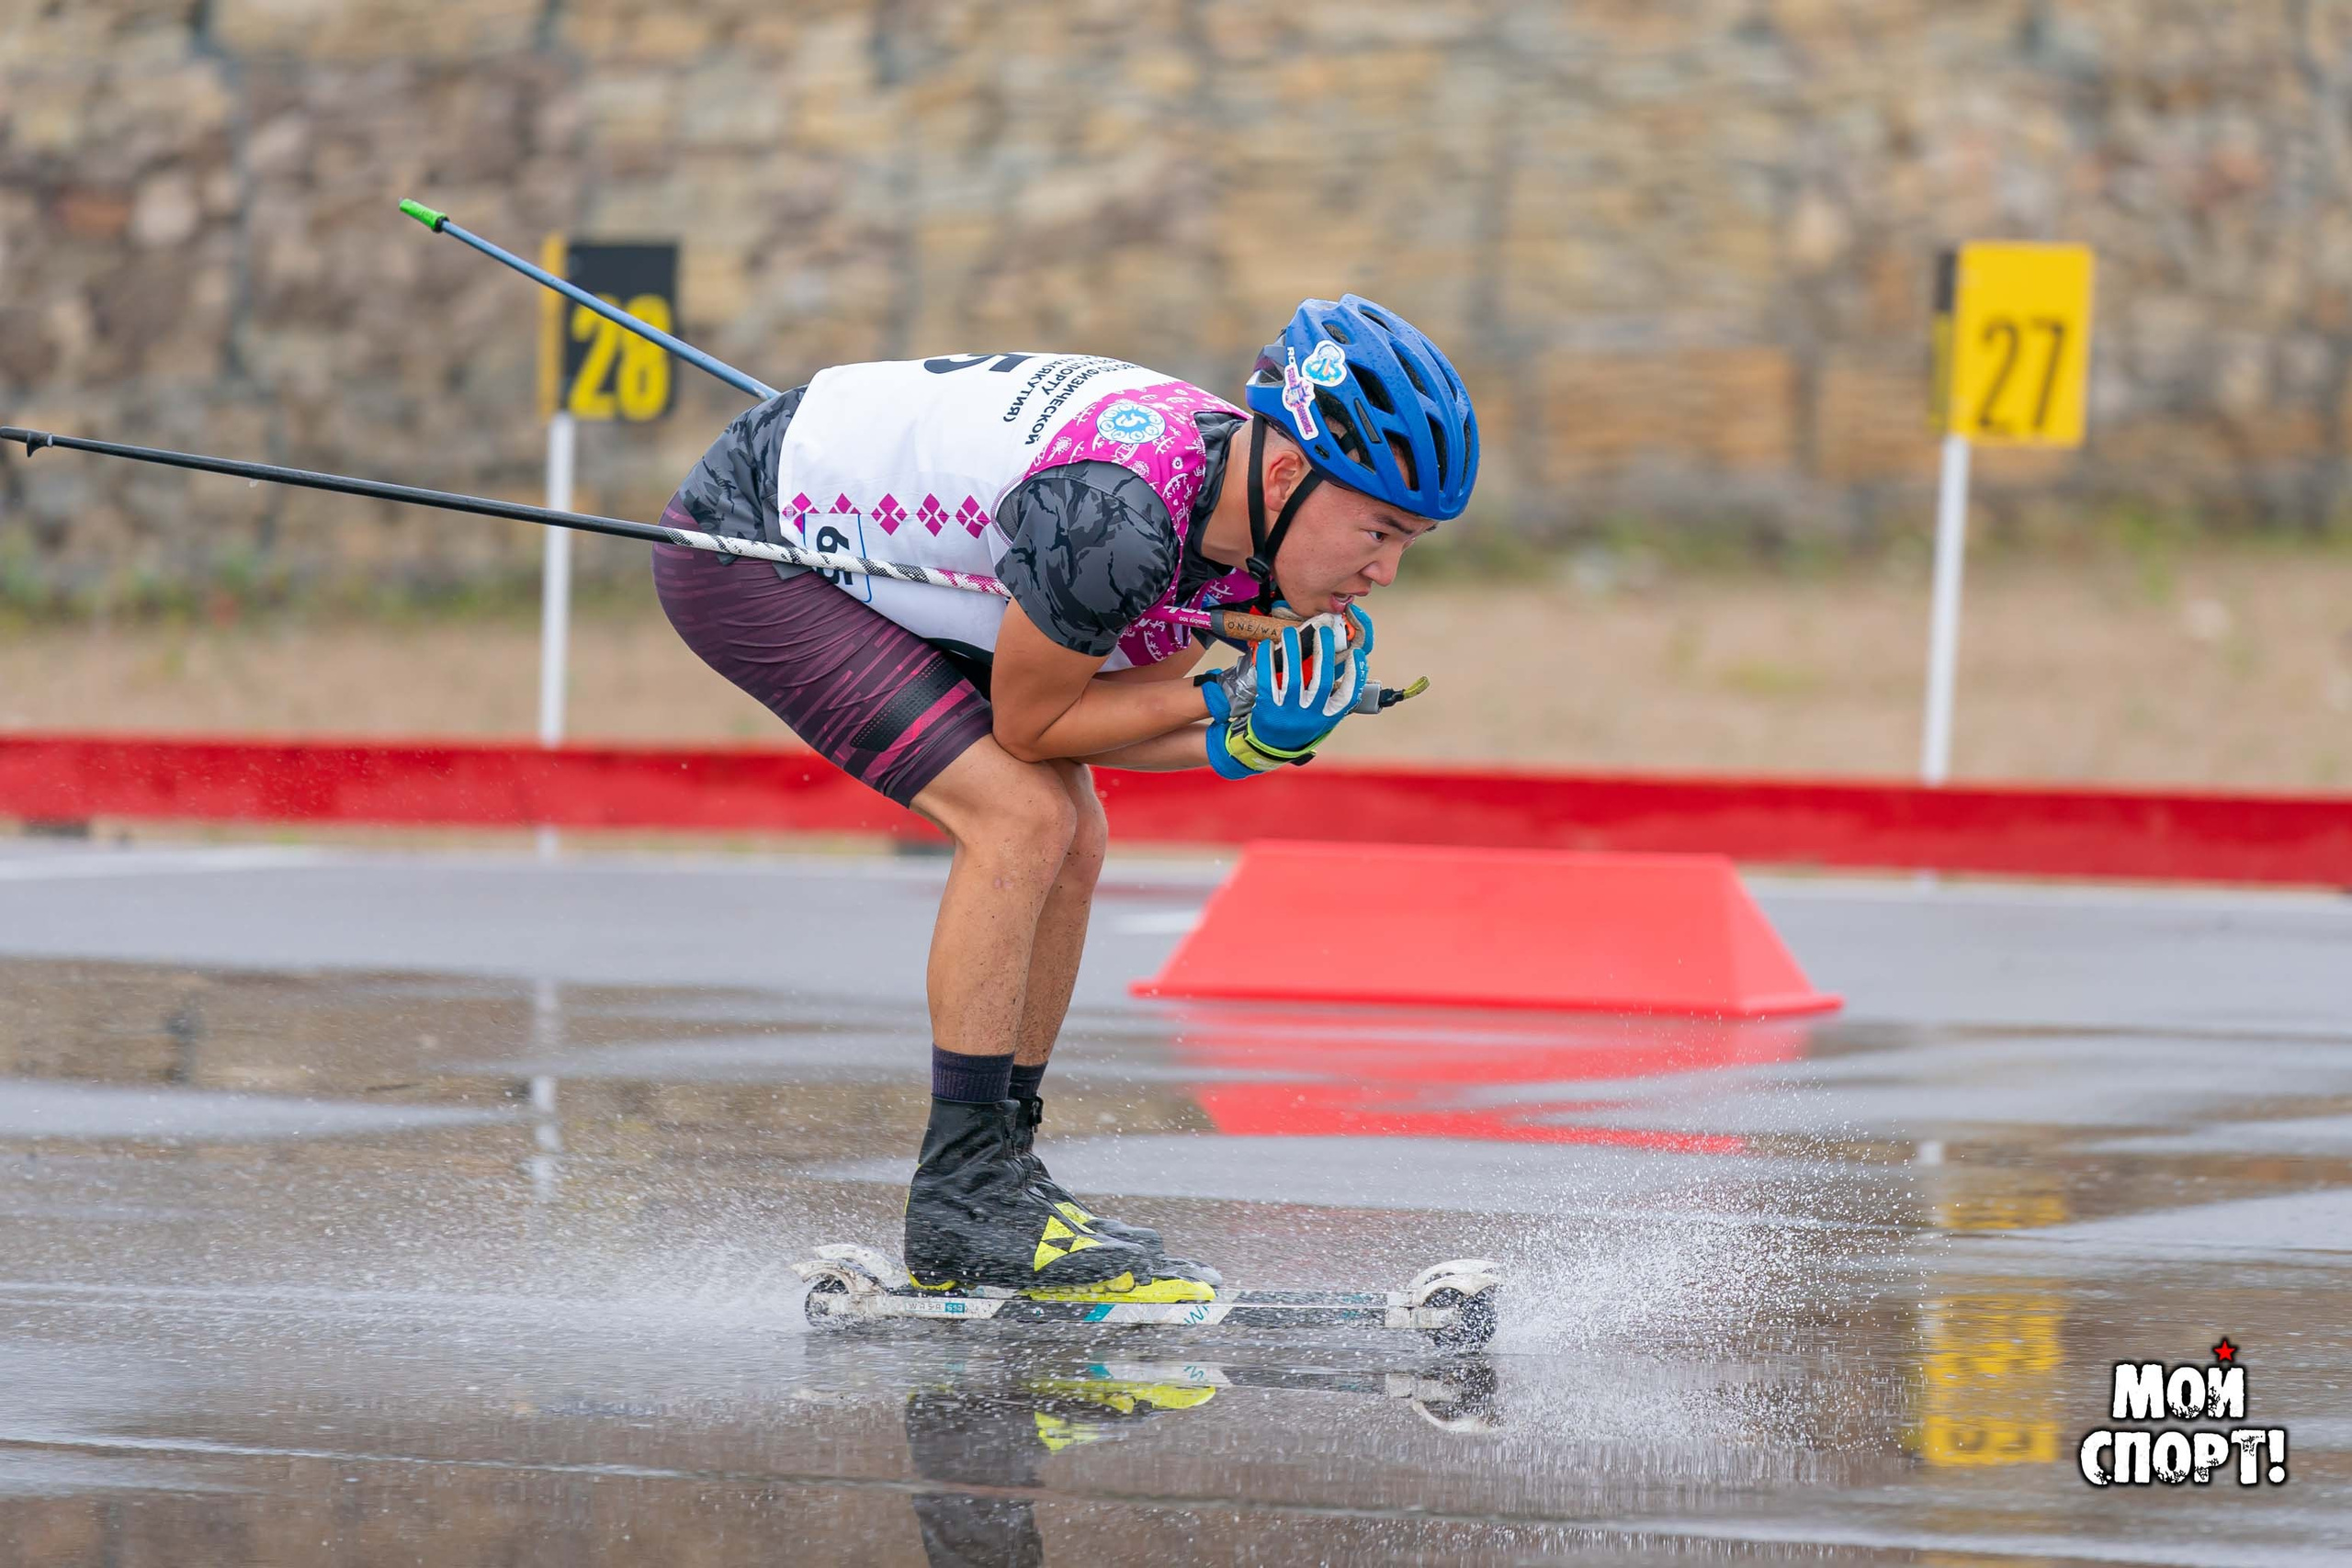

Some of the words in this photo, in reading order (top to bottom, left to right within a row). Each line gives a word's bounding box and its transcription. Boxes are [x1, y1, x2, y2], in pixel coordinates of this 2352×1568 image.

[569, 292, 672, 423] 28
[1024, 367, 1100, 446] ФИЗИЧЕСКОЙ
[1977, 315, 2065, 434] 27
[1227, 621, 1278, 637] ONE/WA
